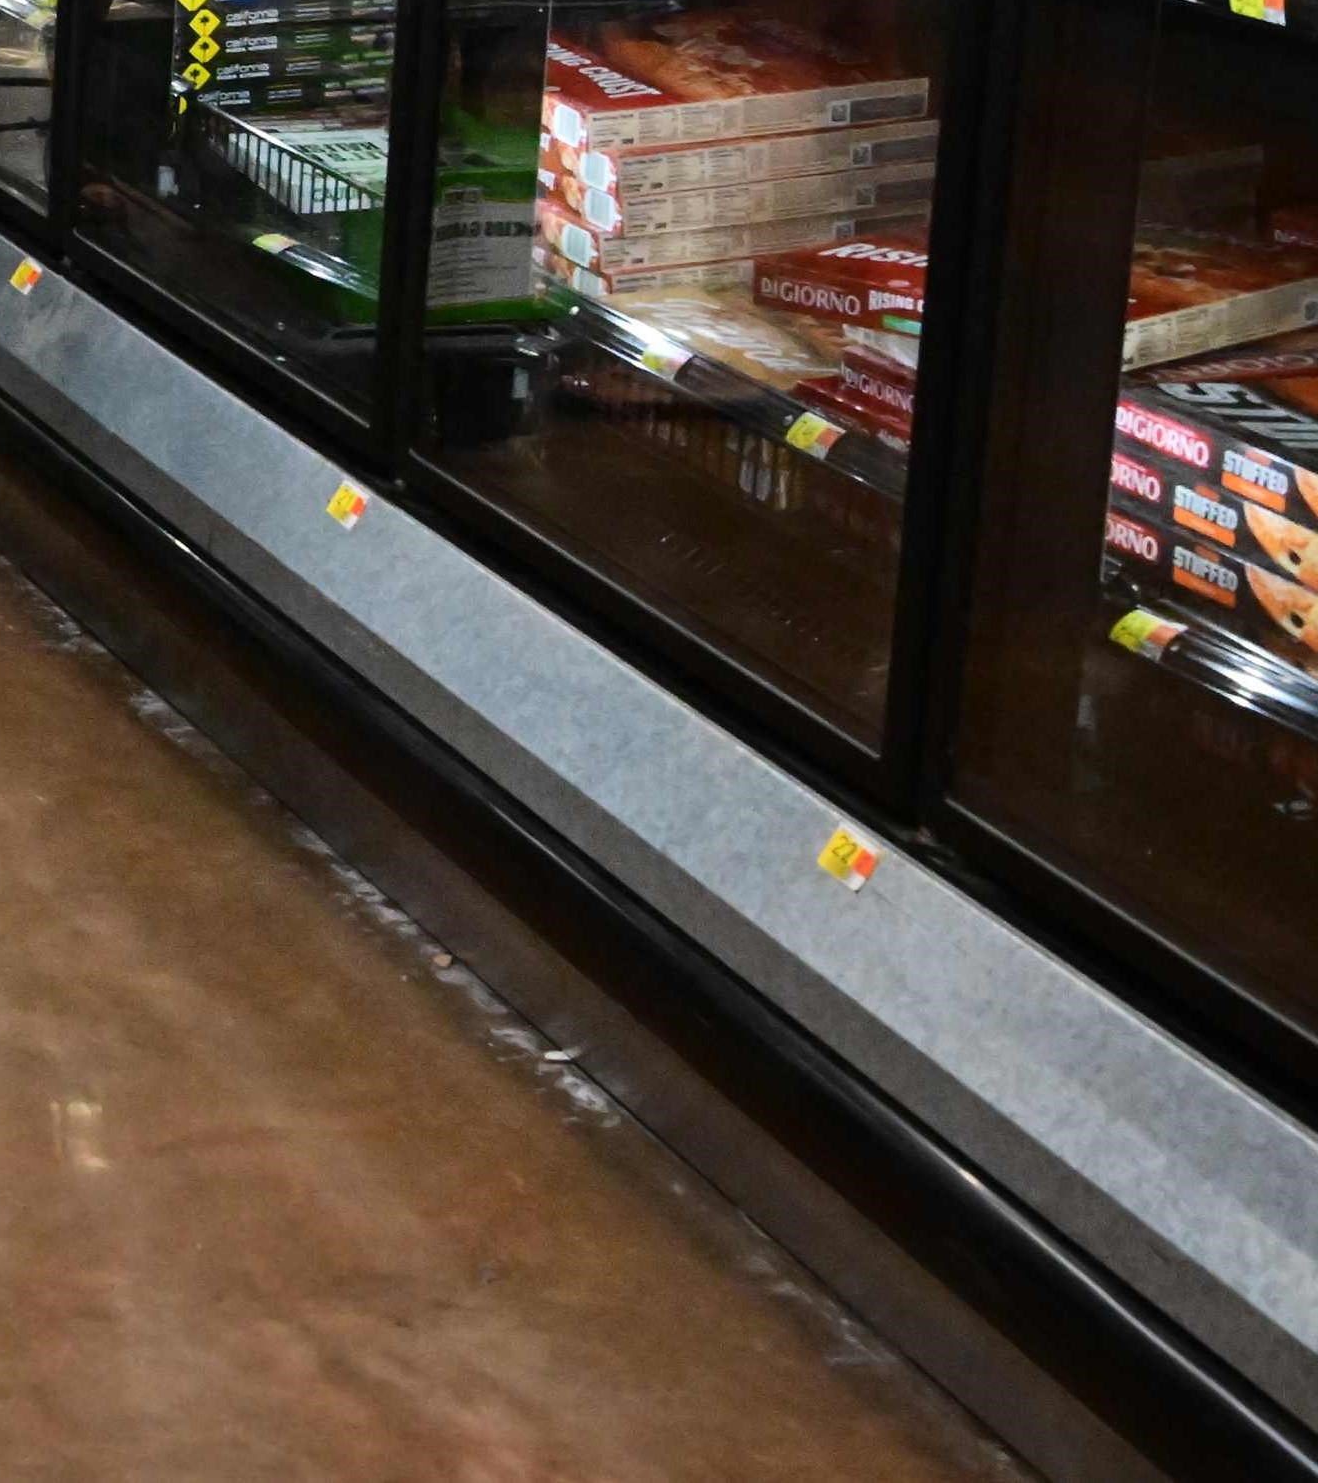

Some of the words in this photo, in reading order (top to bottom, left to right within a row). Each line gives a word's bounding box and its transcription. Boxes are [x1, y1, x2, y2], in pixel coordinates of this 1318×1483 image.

[578, 66, 663, 99] CRUST
[761, 278, 862, 316] DIGIORNO
[868, 290, 914, 311] RISING
[1115, 406, 1210, 468] DIGIORNO
[1222, 449, 1289, 495] STUFFED
[1174, 484, 1238, 531] STUFFED
[1173, 545, 1239, 592] STUFFED
